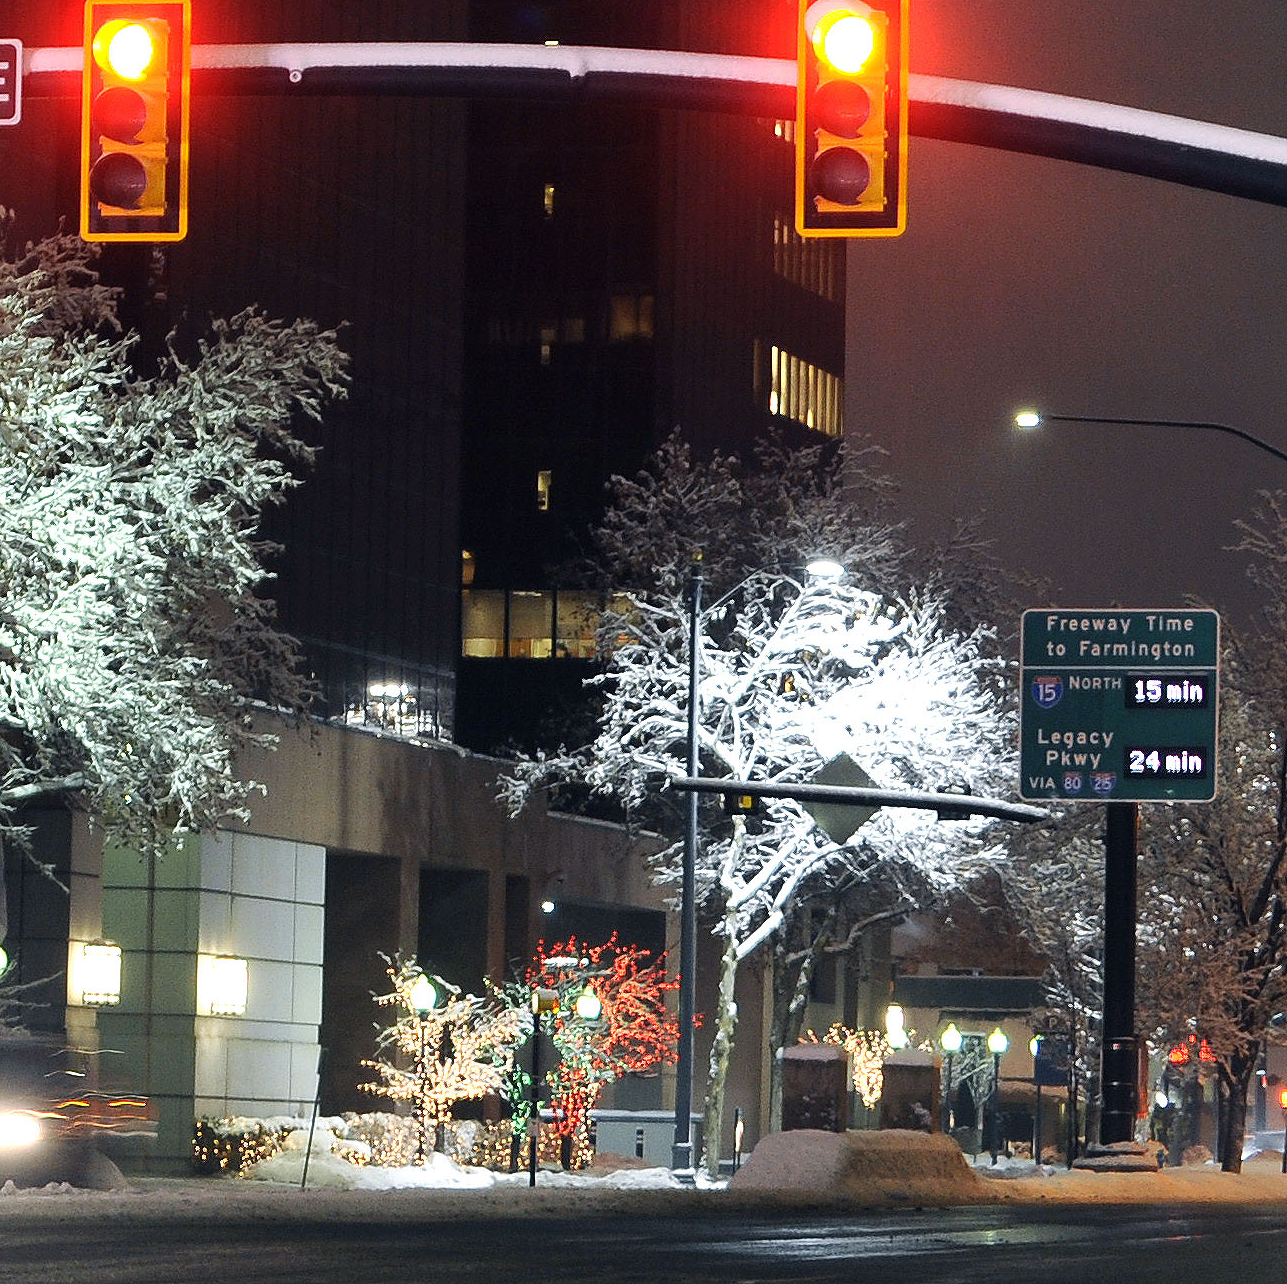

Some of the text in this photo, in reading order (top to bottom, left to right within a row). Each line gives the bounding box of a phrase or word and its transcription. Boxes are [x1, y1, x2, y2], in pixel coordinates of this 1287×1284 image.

[1046, 616, 1195, 634] Freeway Time
[1046, 640, 1195, 660] to Farmington
[1038, 676, 1122, 701] 15 NORTH
[1135, 680, 1203, 703] 15 min
[1038, 729, 1114, 748] Legacy
[1046, 751, 1102, 769] Pkwy
[1129, 751, 1202, 773] 24 min
[1029, 777, 1056, 789] VIA
[1064, 777, 1082, 790] 80
